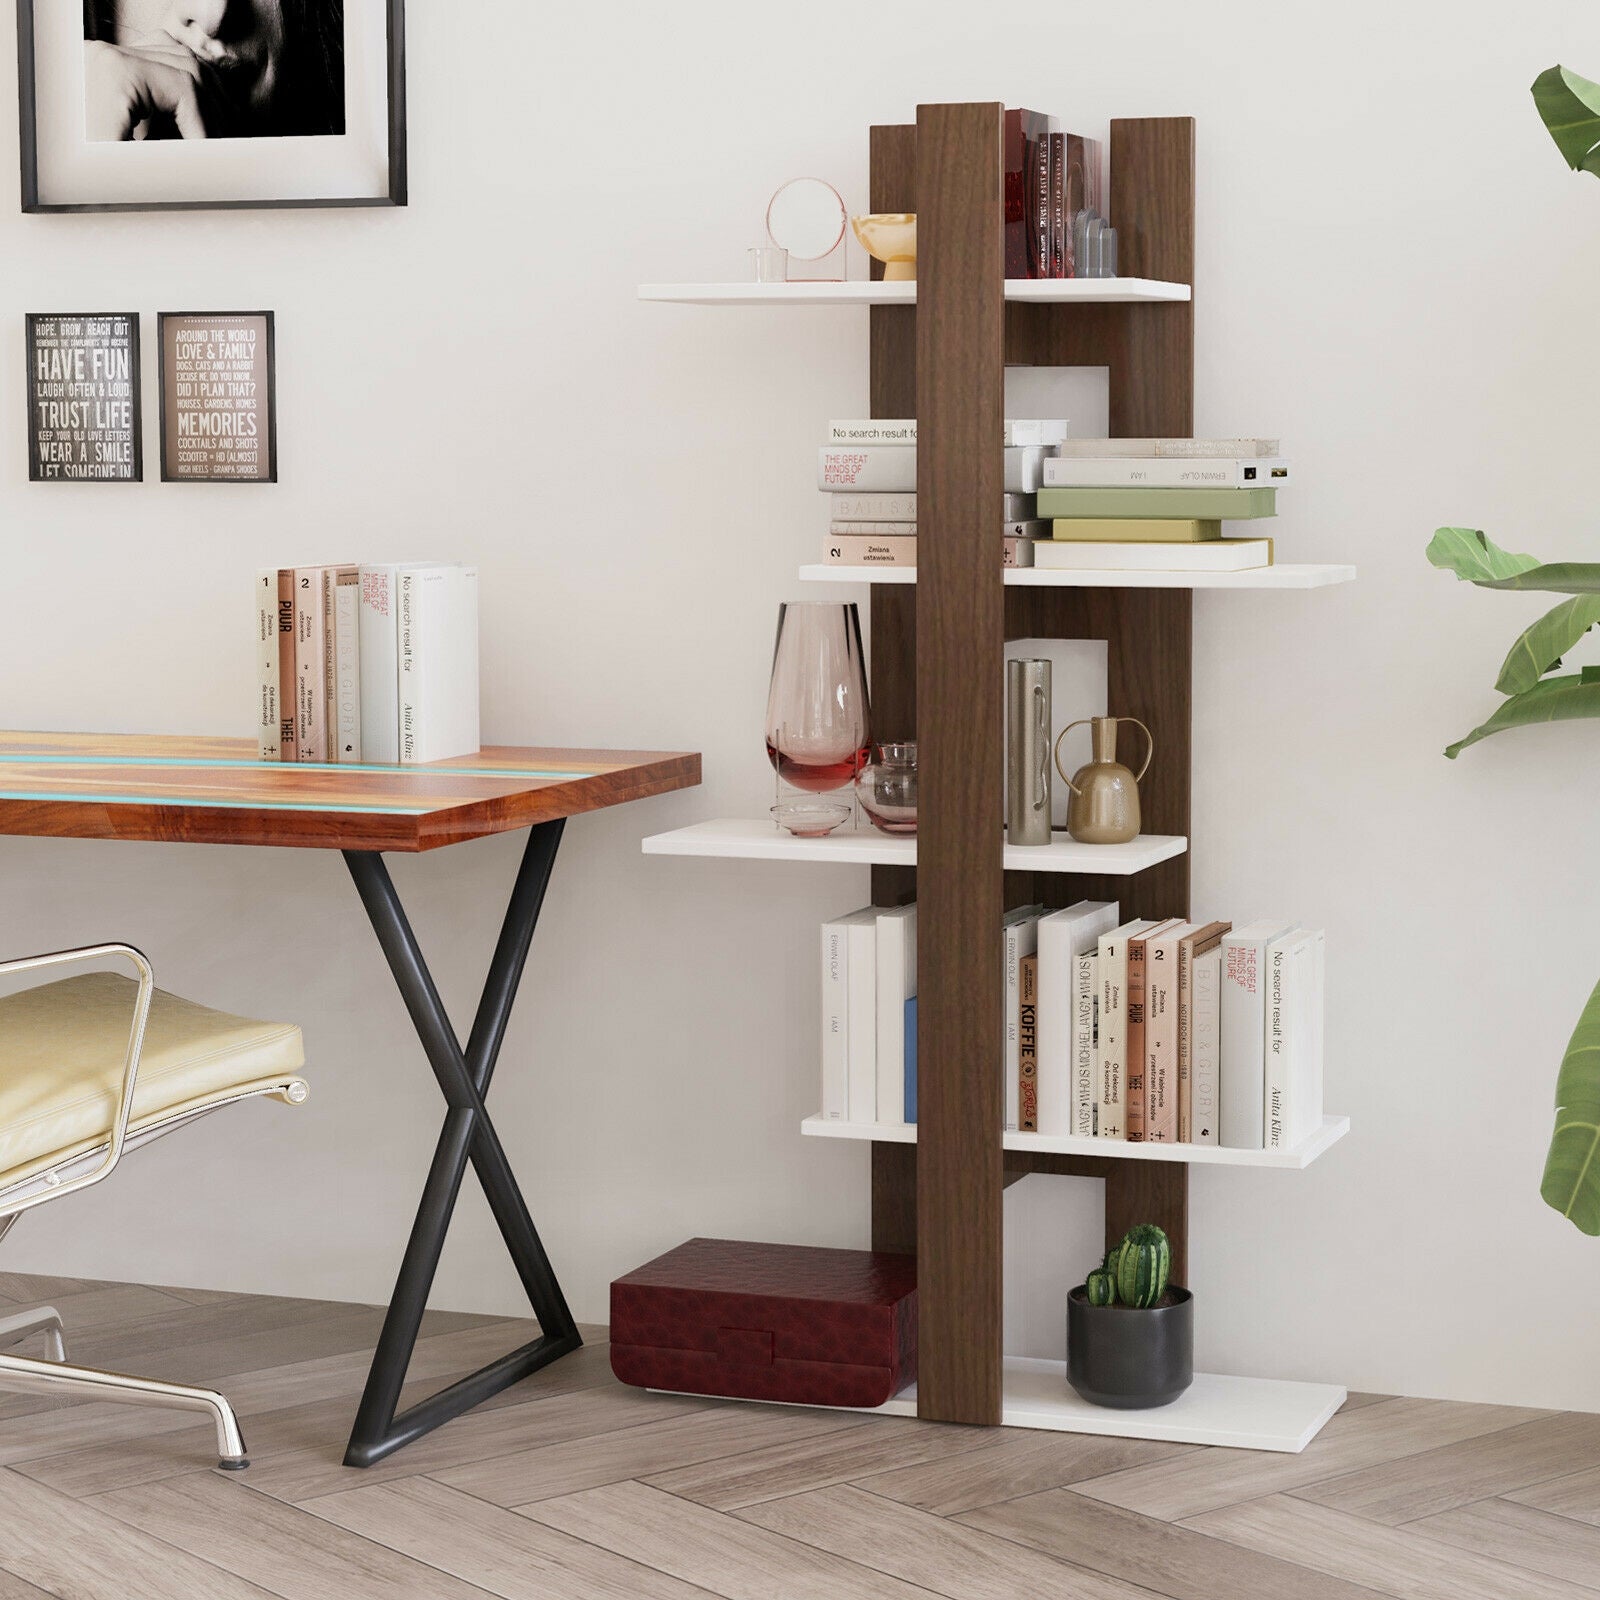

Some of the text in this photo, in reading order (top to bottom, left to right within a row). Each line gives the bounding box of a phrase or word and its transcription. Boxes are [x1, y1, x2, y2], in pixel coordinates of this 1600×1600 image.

[88, 323, 110, 336] REACH
[115, 322, 128, 336] OUT
[176, 330, 256, 342] AROUND THE WORLD
[176, 343, 256, 360] LOVE & FAMILY
[37, 348, 128, 380] HAVE FUN
[196, 360, 211, 370] CATS
[212, 360, 224, 370] AND
[226, 360, 232, 370] A
[232, 360, 254, 370] RABBIT
[176, 372, 198, 382] EXCUSE
[220, 372, 232, 382] YOU
[38, 382, 130, 397] LAUGH OFTEN & LOUD
[177, 383, 192, 397] DID
[201, 383, 224, 397] PLAN
[227, 382, 256, 396] THAT?
[236, 398, 256, 409] HOMES
[38, 401, 130, 429] TRUST LIFE
[178, 412, 257, 436] MEMORIES
[38, 430, 130, 441] KEEP YOUR OLD LOVE LETTERS
[833, 428, 908, 438] No search result
[178, 438, 258, 450] COCKTAILS AND SHOTS
[39, 442, 130, 462] WEAR A SMILE
[178, 451, 258, 464] SCOOTER HD (ALMOST)
[825, 455, 868, 464] THE GREAT
[40, 464, 131, 478] LET SOMEONE IN
[824, 465, 862, 474] MINDS OF
[824, 474, 856, 484] FUTURE
[830, 548, 841, 558] 2
[262, 578, 268, 586] 1
[302, 578, 309, 588] 2
[403, 576, 411, 591] No
[380, 574, 388, 616] THE GREAT
[372, 600, 379, 610] OF
[403, 593, 412, 626] search
[279, 600, 292, 632] PUUR
[404, 658, 412, 672] for
[281, 718, 293, 742] THEE
[404, 704, 413, 760] Anita Klinz
[1108, 947, 1114, 956] 1
[1130, 946, 1143, 961] THEE
[1155, 950, 1164, 960] 2
[1228, 947, 1236, 980] FUTURE
[1237, 947, 1246, 986] MINDS OF
[1247, 949, 1256, 993] THE GREAT
[1272, 951, 1283, 1054] No search result for
[1129, 1003, 1143, 1024] PUUR
[1022, 1004, 1035, 1057] KOFFIE
[1104, 1061, 1111, 1069] do
[1112, 1063, 1119, 1072] Od
[1129, 1074, 1142, 1090] THEE
[1199, 1059, 1211, 1119] GLORY
[1271, 1087, 1282, 1147] Anita Klinz
